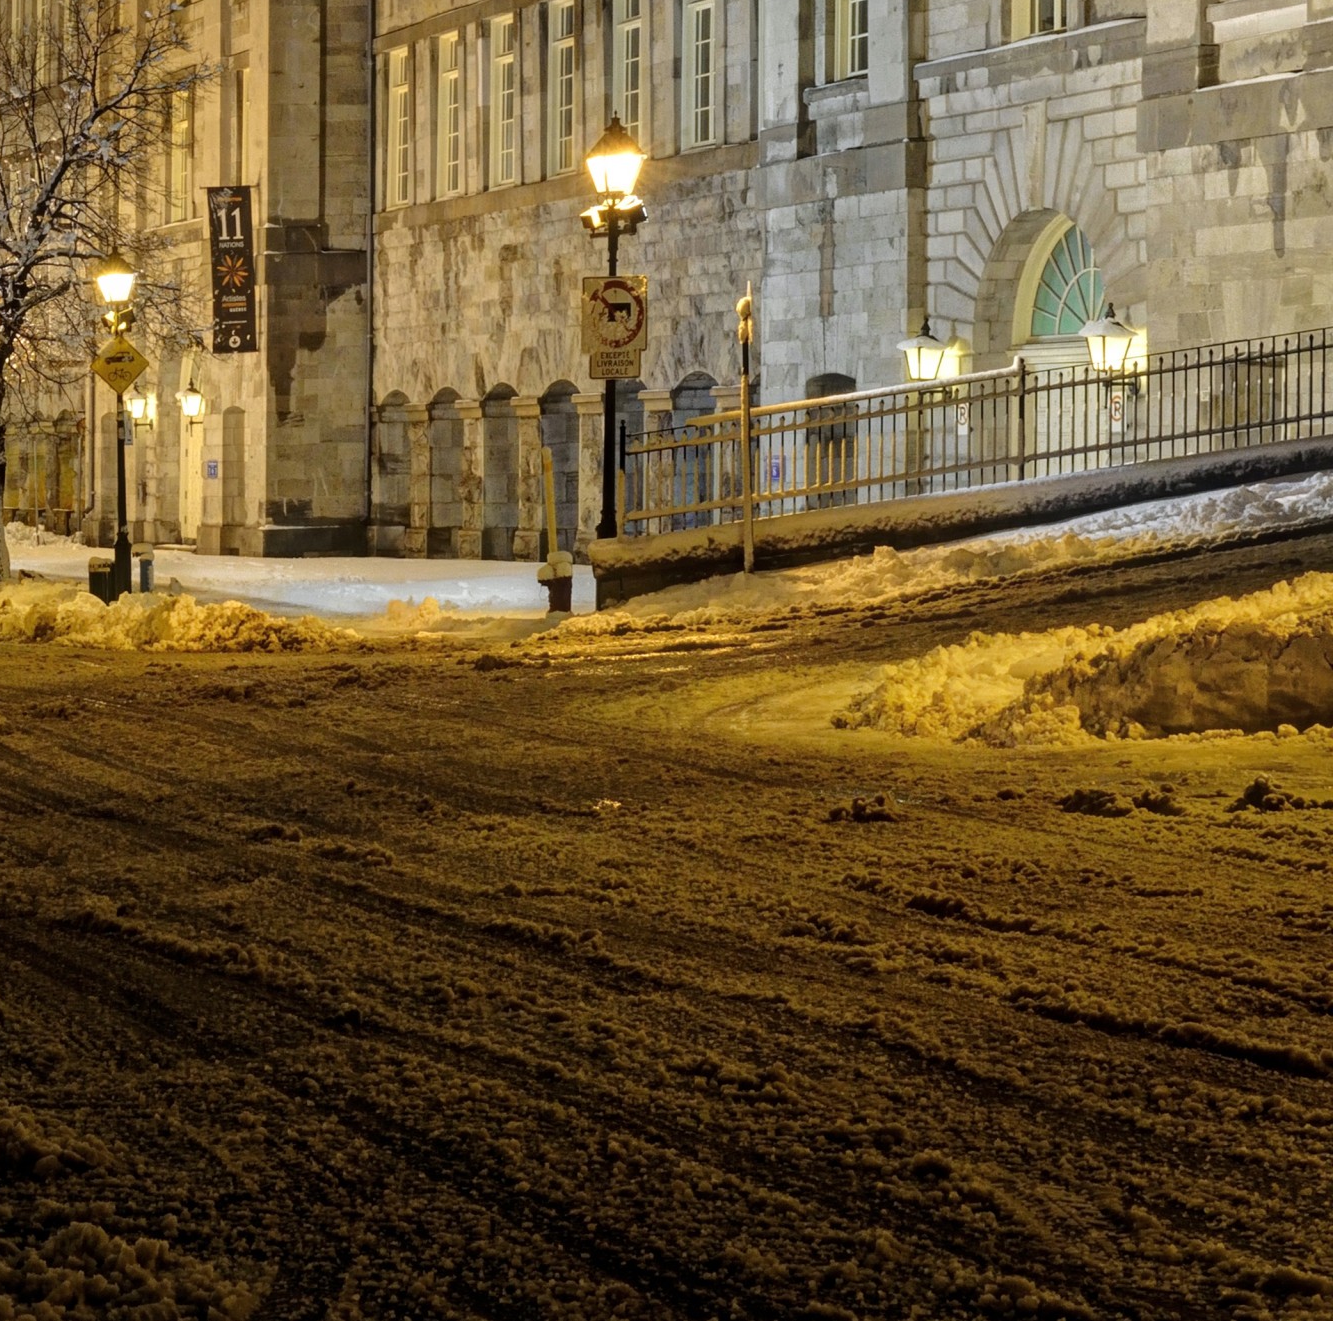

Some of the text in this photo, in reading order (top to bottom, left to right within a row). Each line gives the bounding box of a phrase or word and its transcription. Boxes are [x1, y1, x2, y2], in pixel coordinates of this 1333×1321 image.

[217, 206, 244, 240] 11
[218, 241, 244, 249] NATIONS
[596, 359, 634, 368] LIVRAISON
[601, 367, 629, 376] LOCALE
